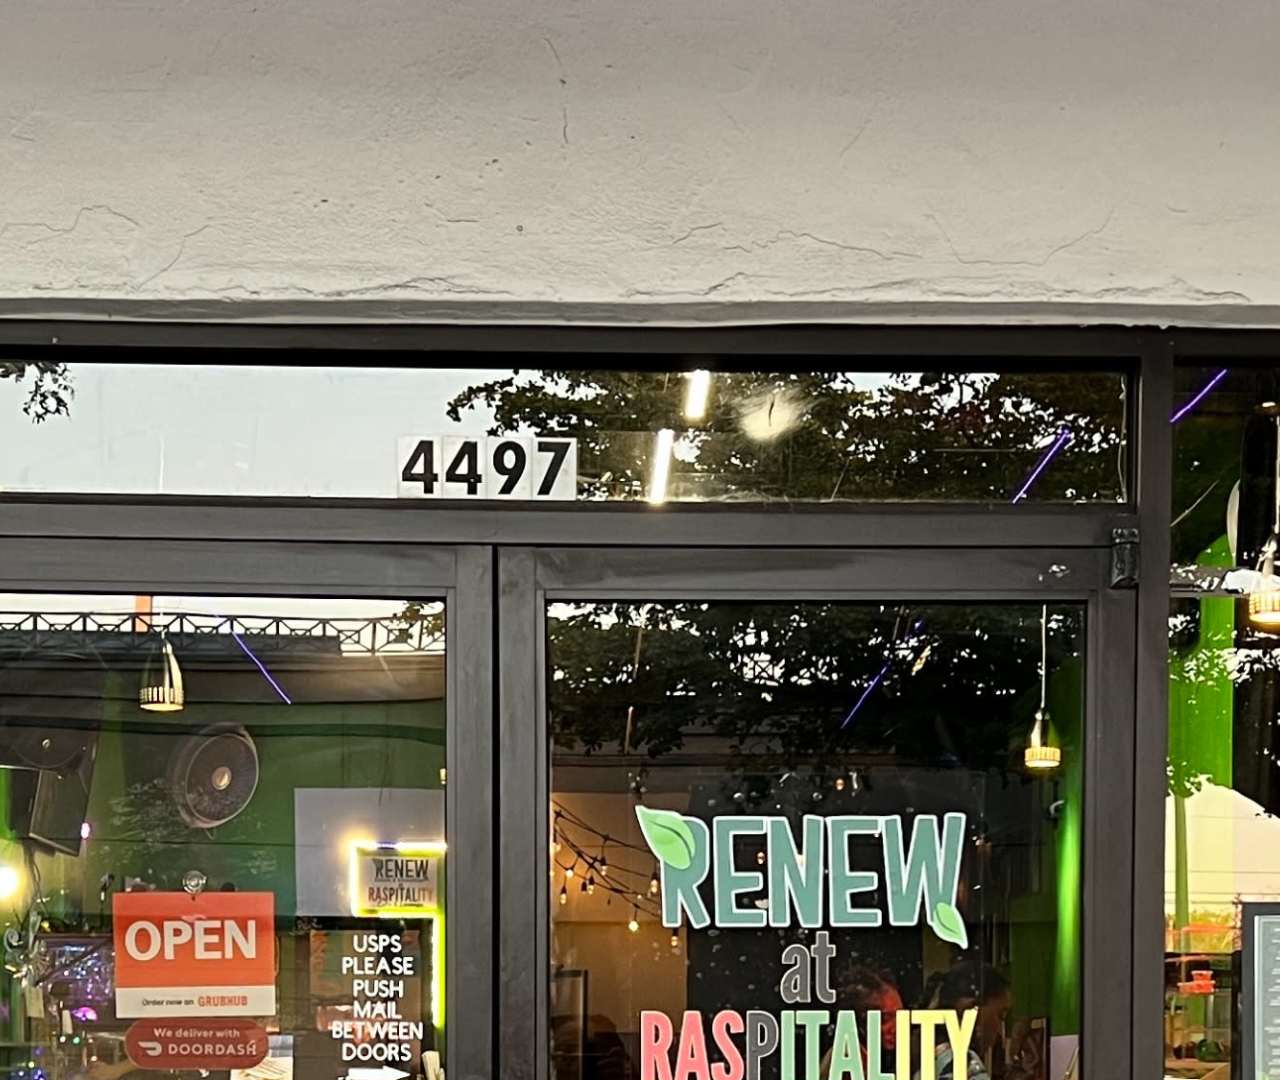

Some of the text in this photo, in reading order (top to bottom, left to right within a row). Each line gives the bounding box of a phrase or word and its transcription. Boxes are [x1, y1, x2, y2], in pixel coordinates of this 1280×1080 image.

[402, 440, 571, 495] 4497
[372, 859, 429, 880] RENEW
[659, 812, 967, 929] RENEW
[368, 887, 433, 902] RASPITALITY
[124, 920, 256, 961] OPEN
[353, 934, 402, 952] USPS
[342, 956, 414, 975] PLEASE
[780, 931, 836, 1004] at
[353, 980, 404, 998] PUSH
[198, 996, 247, 1007] GRUBHUB
[353, 1000, 402, 1019] MAIL
[153, 1028, 240, 1038] We deliver with
[332, 1021, 424, 1041] BETWEEN
[168, 1041, 257, 1056] DOORDASH
[342, 1042, 412, 1061] DOORS
